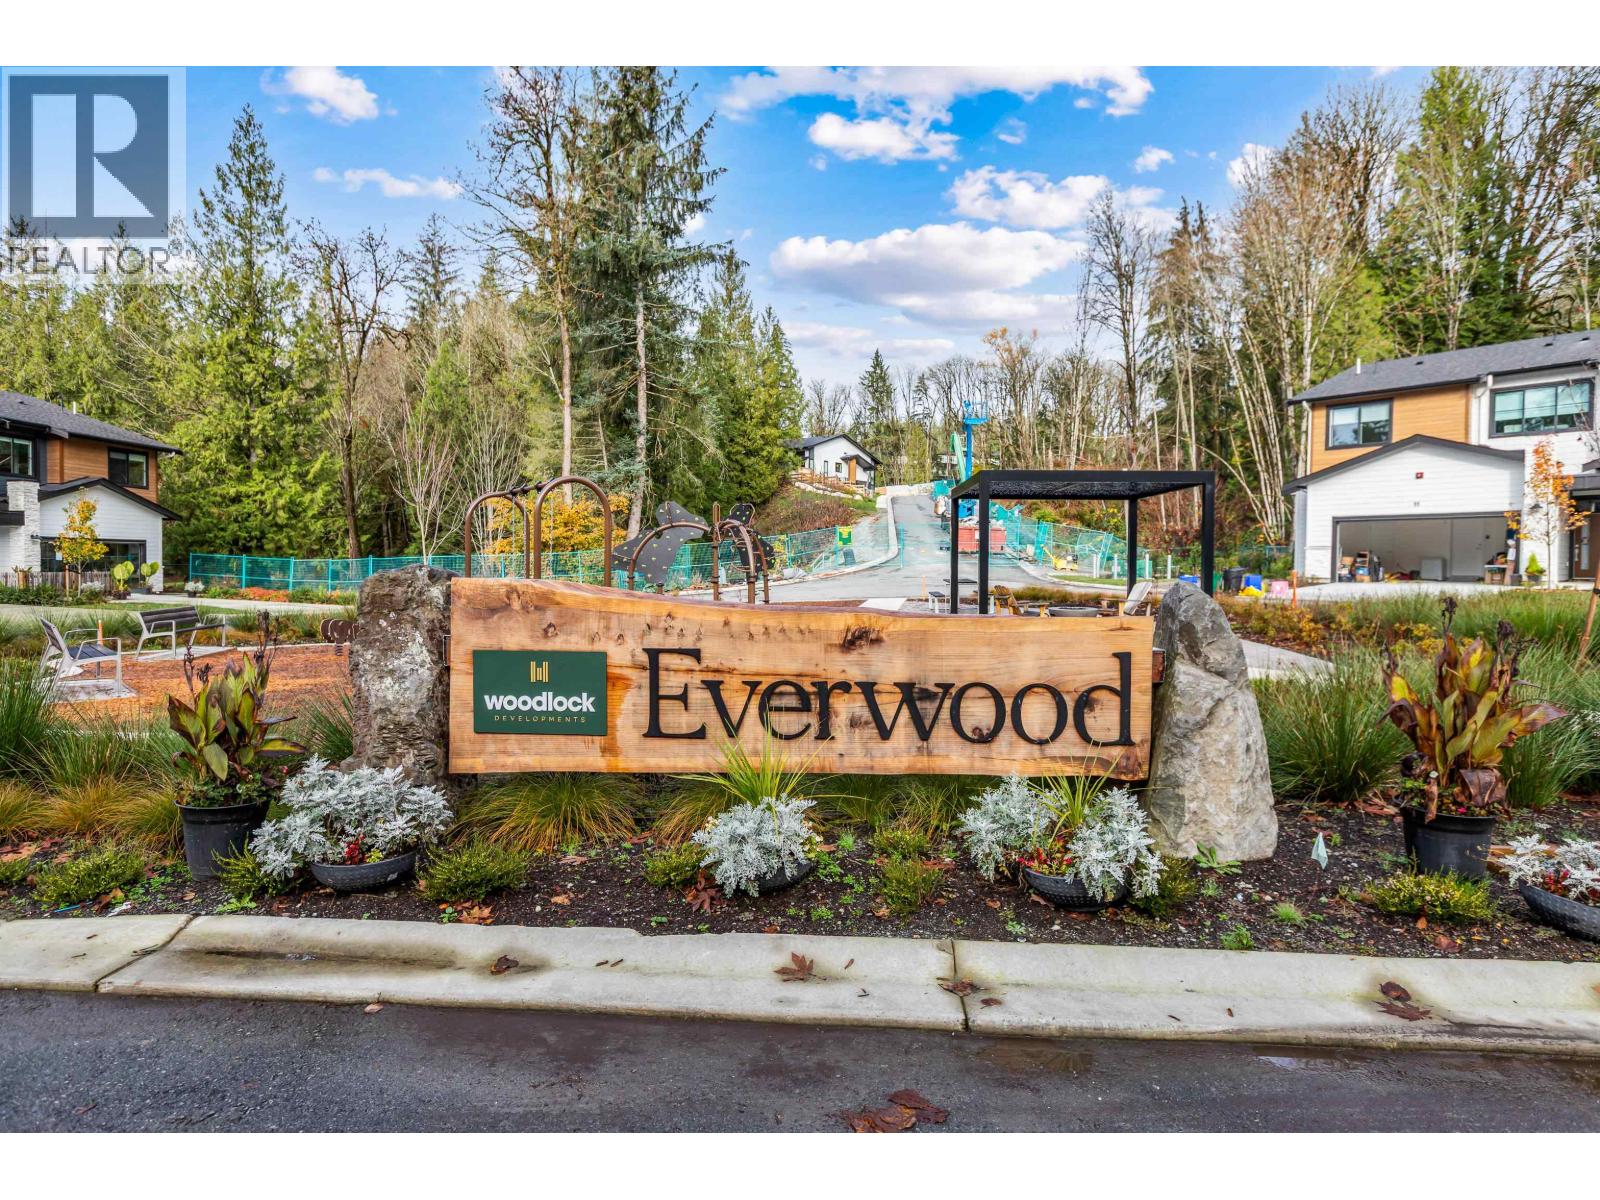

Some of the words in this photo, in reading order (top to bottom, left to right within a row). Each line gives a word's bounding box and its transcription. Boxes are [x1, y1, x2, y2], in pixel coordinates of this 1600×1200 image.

[483, 691, 596, 713] woodlock
[641, 647, 1137, 747] Everwood
[494, 715, 586, 723] DEVELOPMENTS
